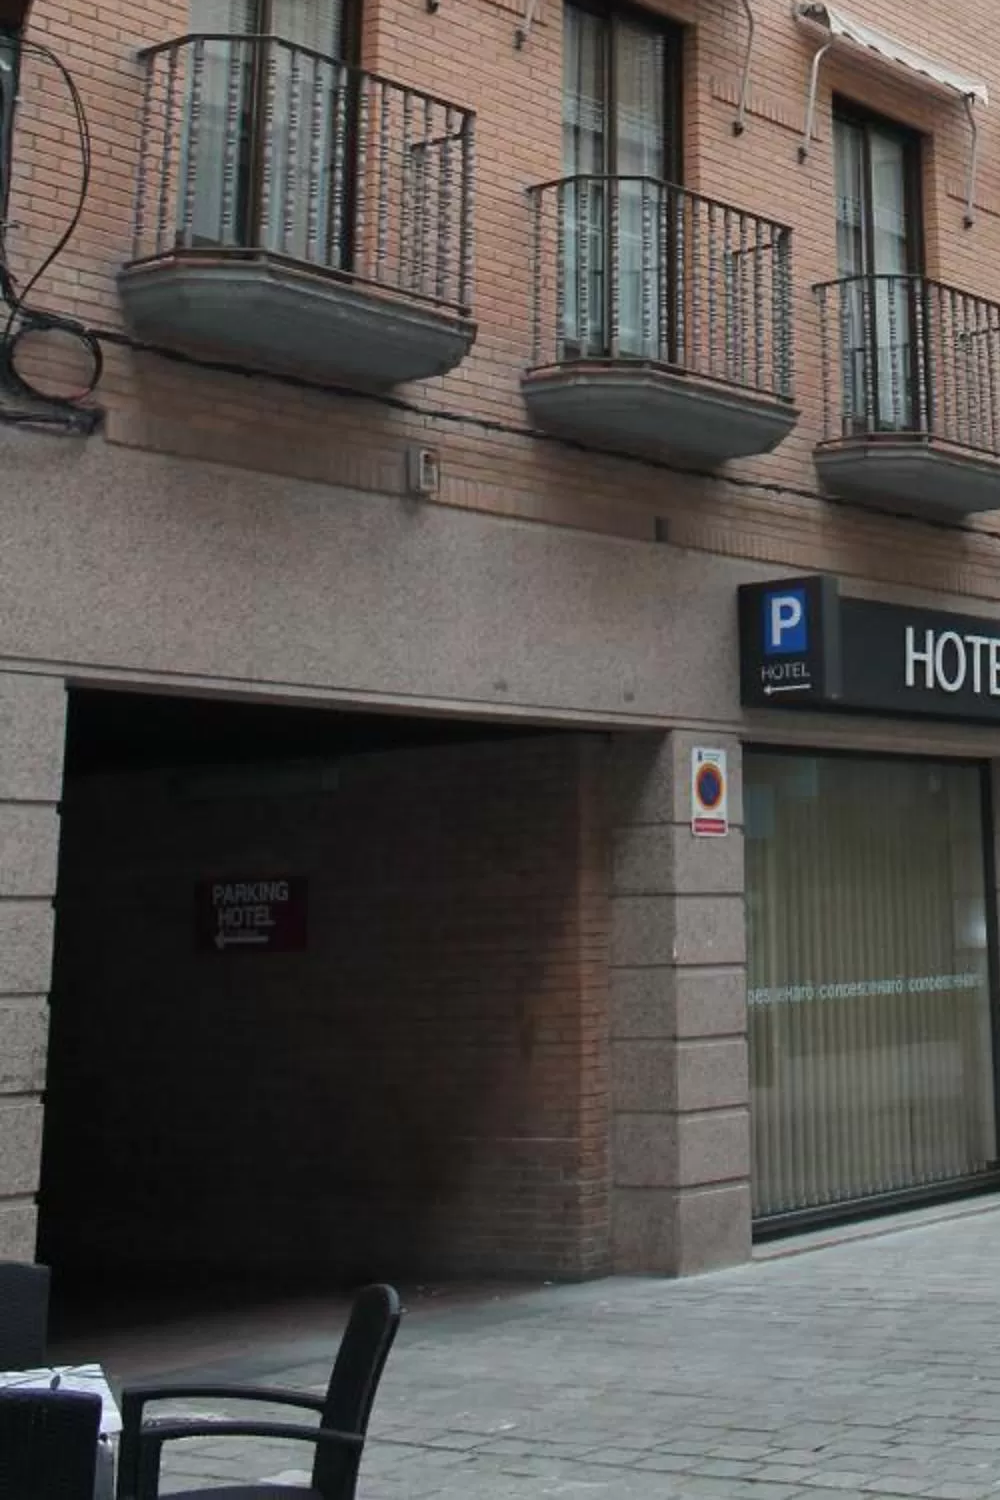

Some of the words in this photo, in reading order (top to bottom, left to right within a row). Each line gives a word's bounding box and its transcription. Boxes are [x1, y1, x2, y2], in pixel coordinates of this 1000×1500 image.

[771, 596, 801, 646] P
[761, 662, 811, 682] HOTEL
[212, 880, 289, 905] PARKING
[217, 904, 276, 929] HOTEL
